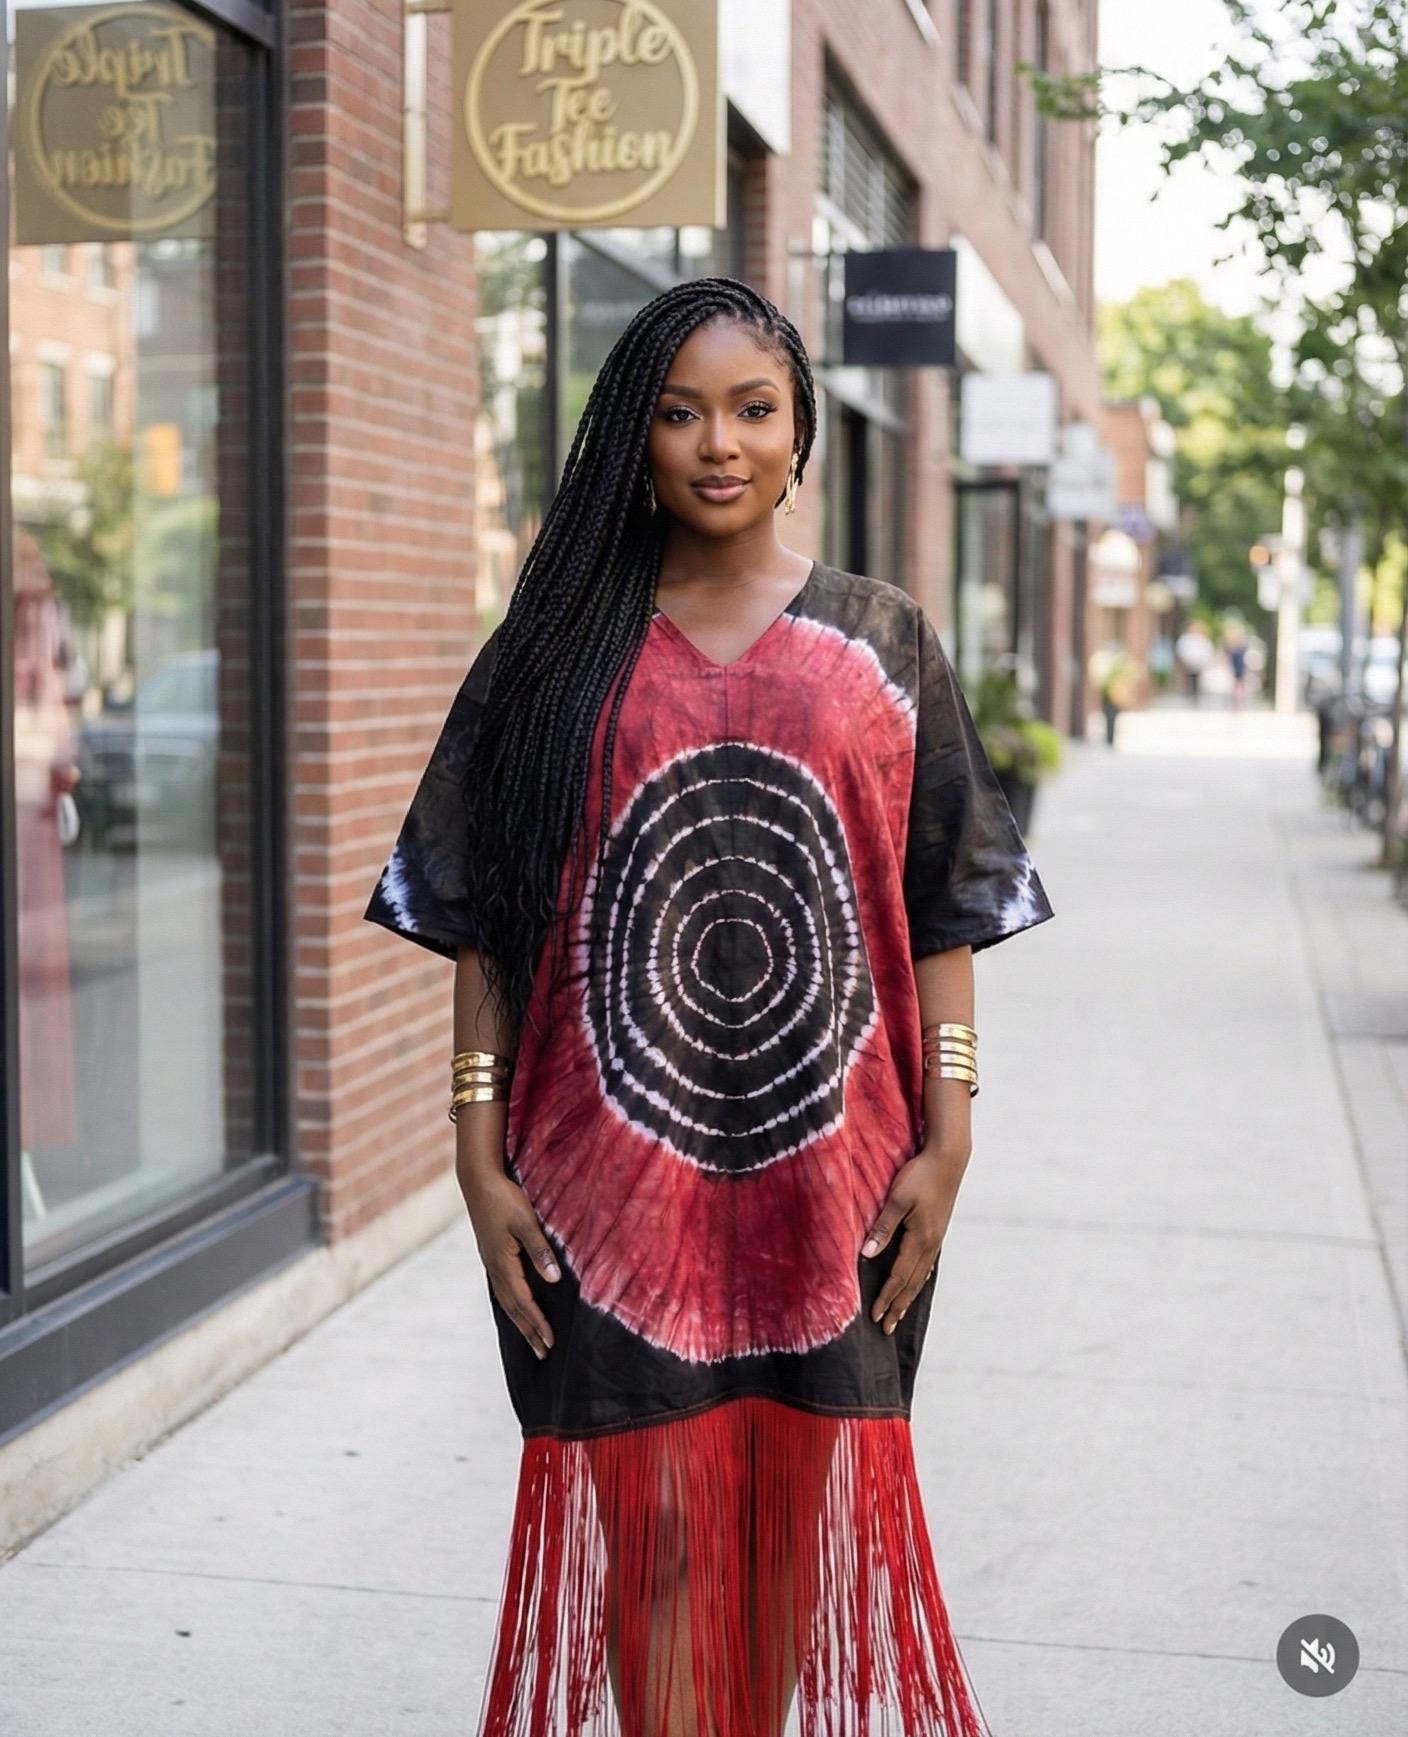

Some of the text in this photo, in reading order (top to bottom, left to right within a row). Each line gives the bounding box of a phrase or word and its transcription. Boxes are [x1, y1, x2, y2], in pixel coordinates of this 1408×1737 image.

[515, 0, 673, 80] Triple
[536, 76, 618, 132] Tee
[489, 123, 672, 187] Fashion
